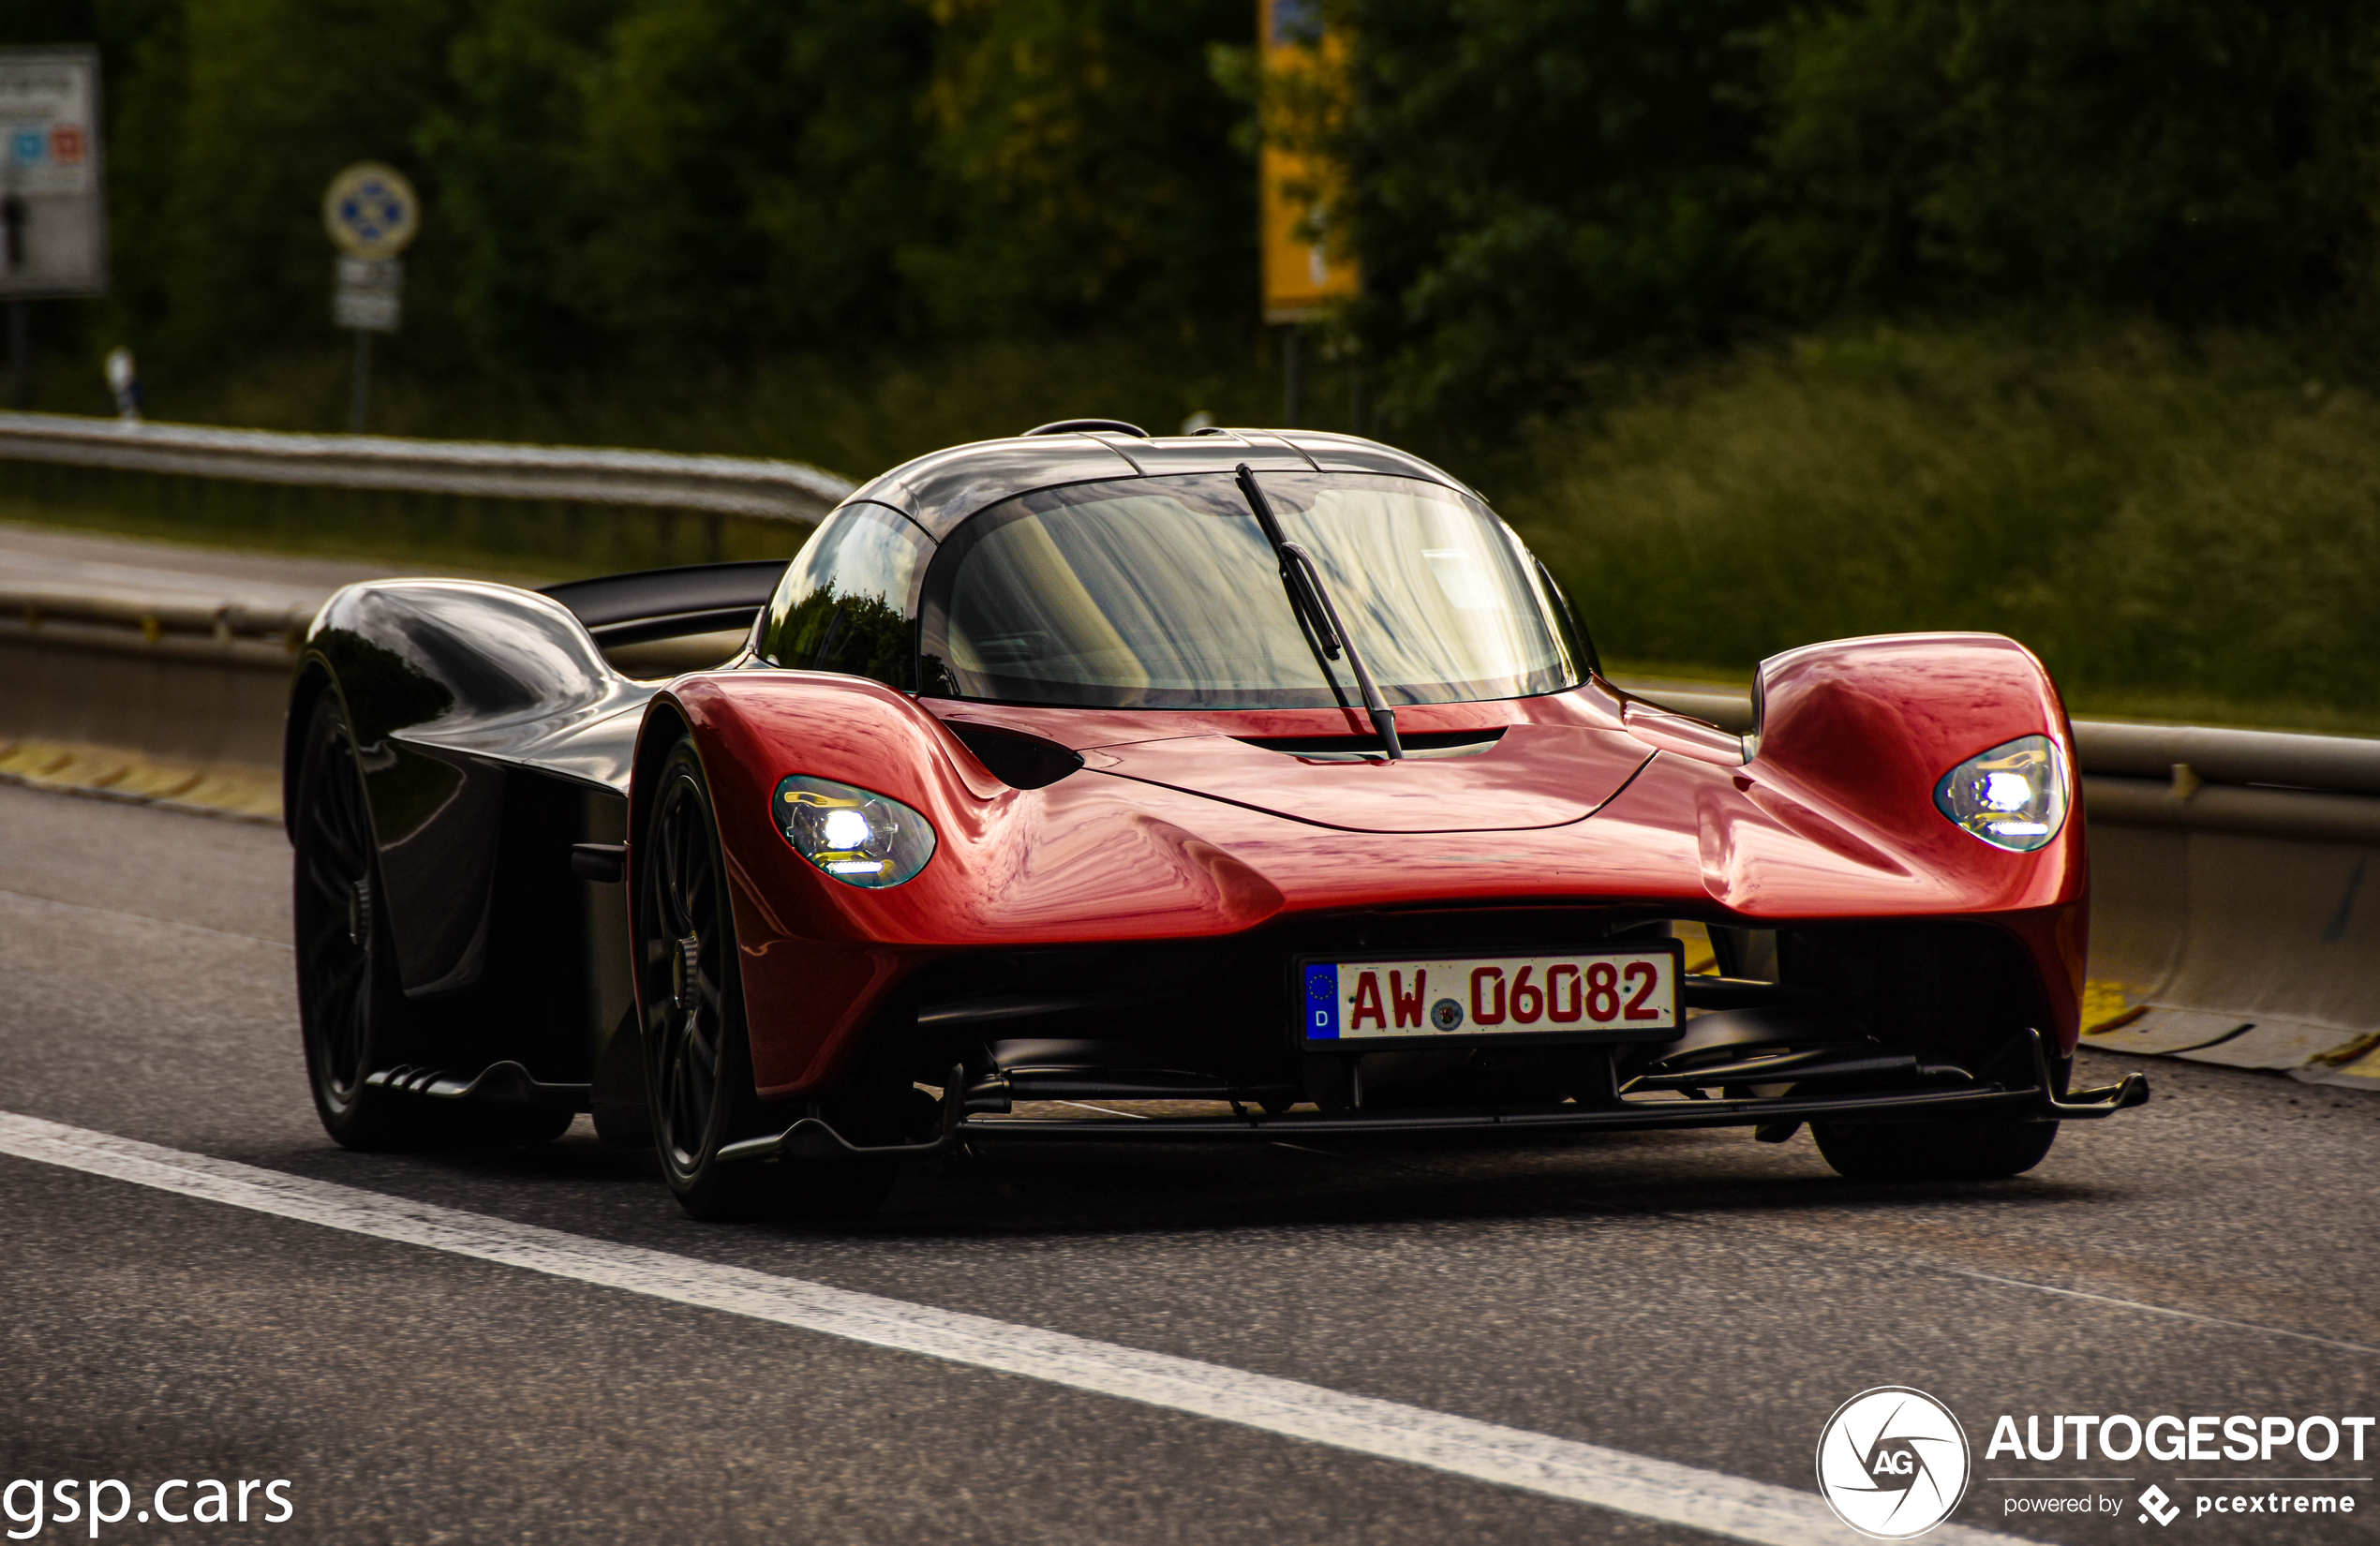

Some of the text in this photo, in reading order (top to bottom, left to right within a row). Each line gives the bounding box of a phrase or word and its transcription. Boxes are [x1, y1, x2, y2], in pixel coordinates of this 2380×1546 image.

[1350, 961, 1659, 1030] AW 06082
[1316, 1010, 1328, 1027] D
